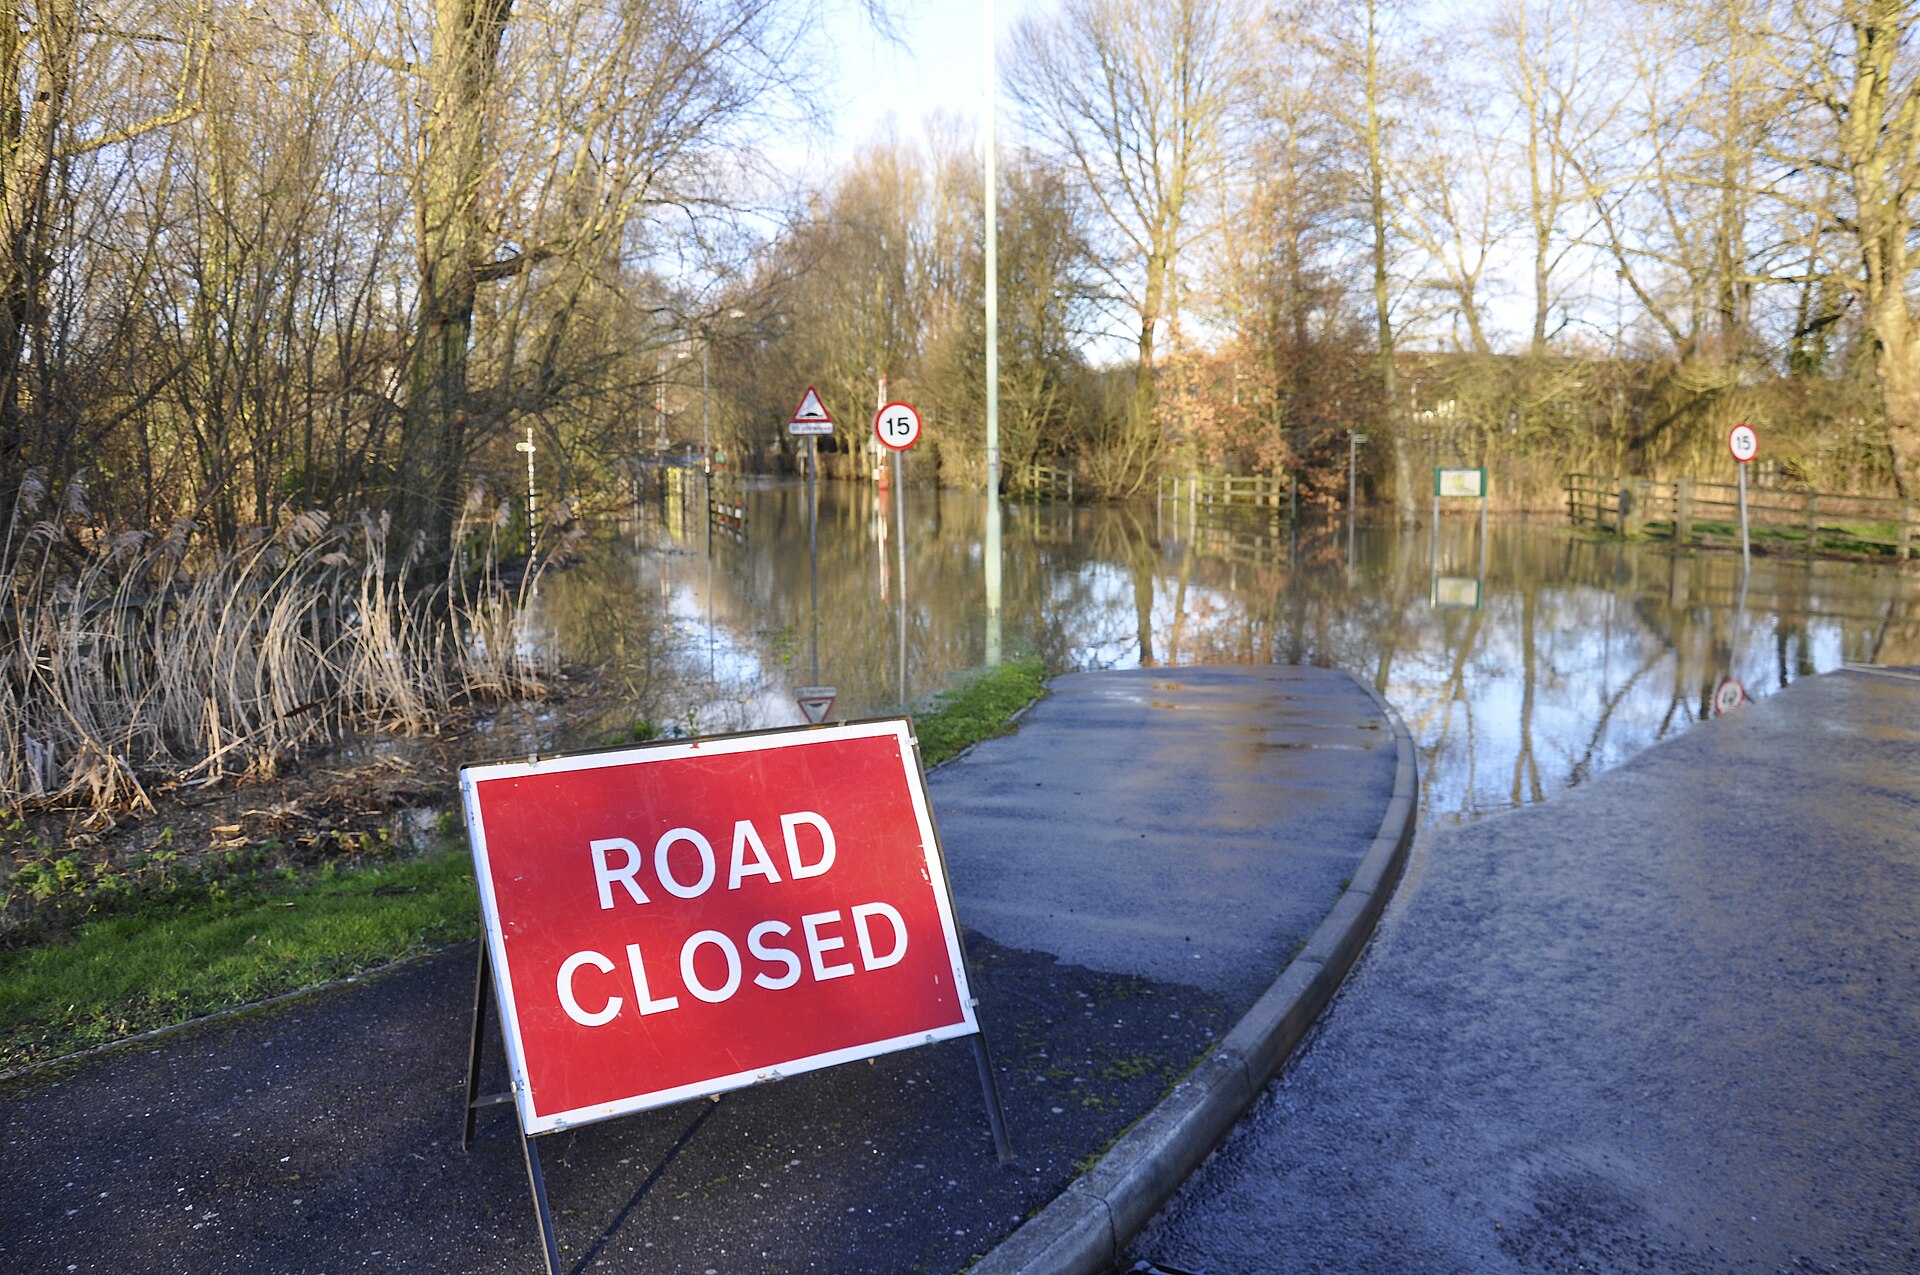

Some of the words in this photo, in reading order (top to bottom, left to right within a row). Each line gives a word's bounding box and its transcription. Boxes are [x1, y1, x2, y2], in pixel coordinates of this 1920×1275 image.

[886, 416, 910, 435] 15
[1737, 435, 1750, 450] 15
[590, 811, 837, 910] ROAD
[556, 901, 908, 1027] CLOSED
